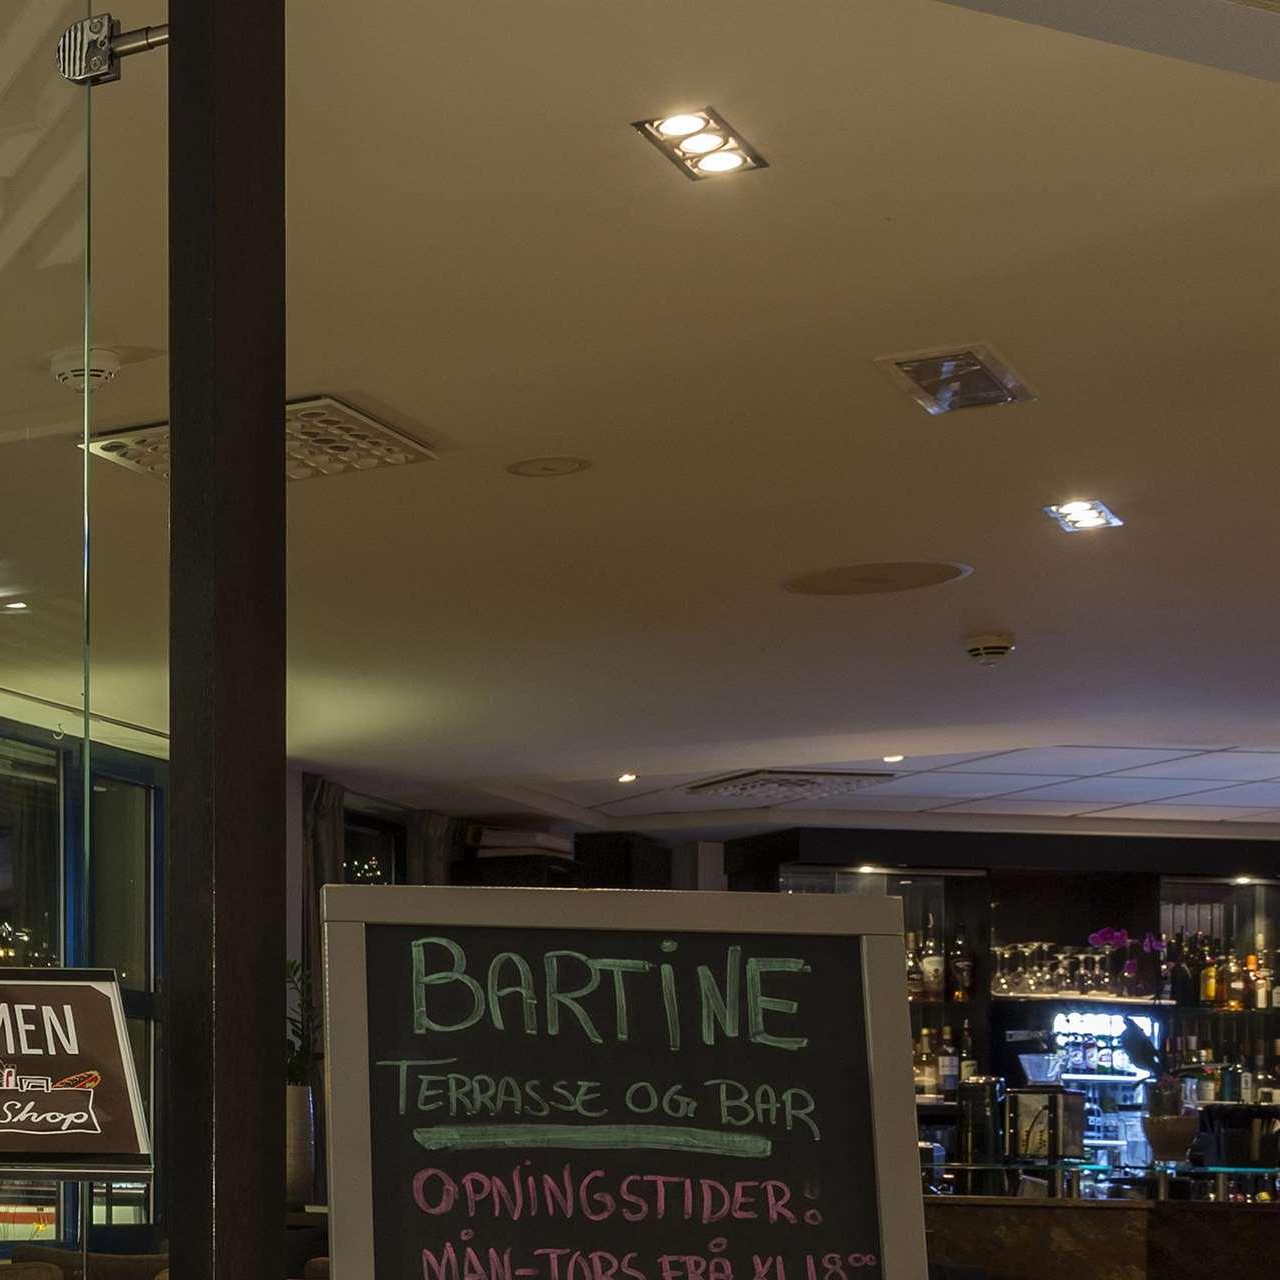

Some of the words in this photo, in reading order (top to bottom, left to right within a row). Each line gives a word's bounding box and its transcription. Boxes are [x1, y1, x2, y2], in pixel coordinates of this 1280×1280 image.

[377, 1058, 608, 1117] TERRASSE
[626, 1081, 697, 1118] OG
[704, 1079, 821, 1141] BAR
